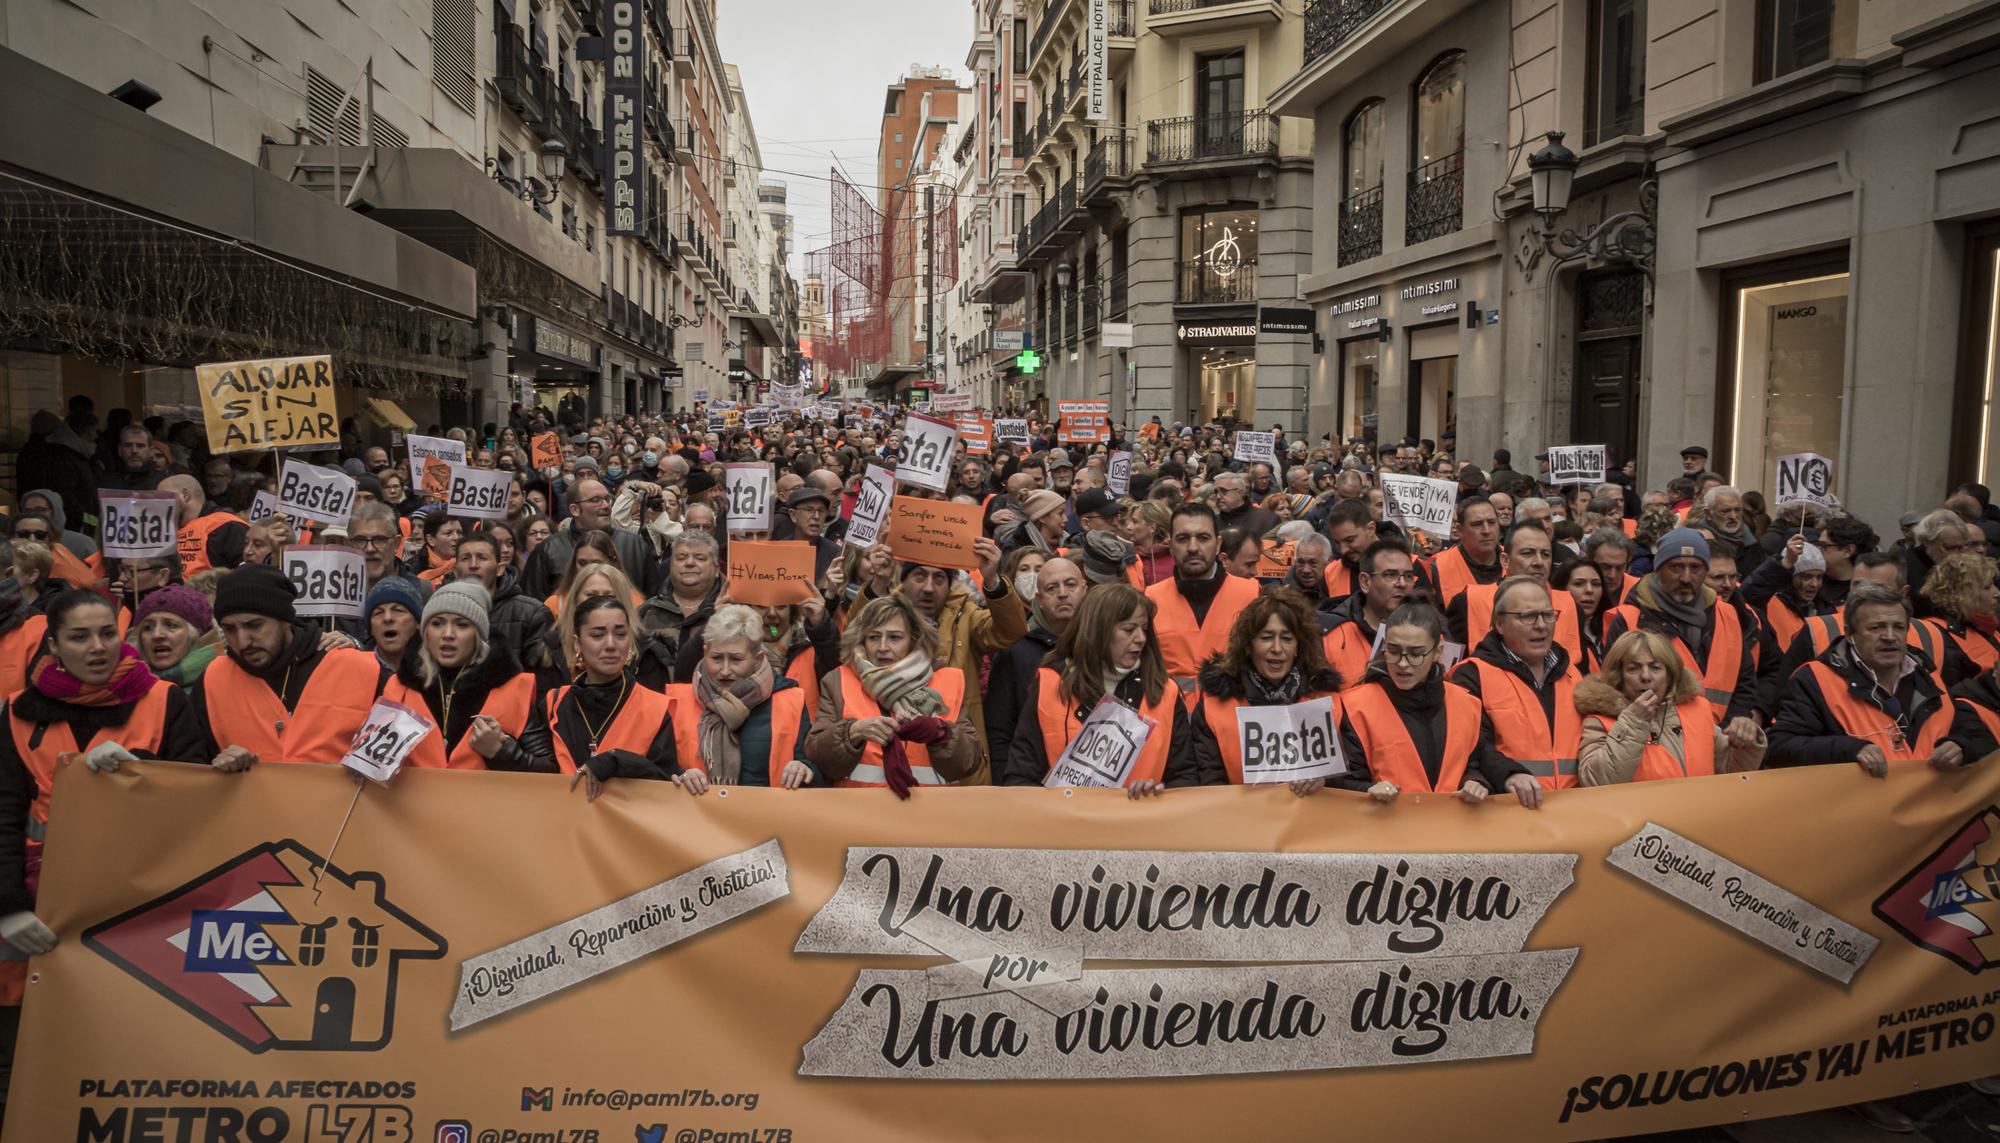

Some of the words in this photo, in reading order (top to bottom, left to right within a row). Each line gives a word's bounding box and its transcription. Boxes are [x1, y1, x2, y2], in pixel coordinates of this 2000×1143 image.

[1092, 34, 1103, 115] PETITPALACE
[614, 94, 634, 231] SPORT
[1330, 294, 1379, 316] intimissimi
[1400, 278, 1457, 301] intimissimi
[1187, 325, 1257, 337] STRADIVARIUS
[1777, 306, 1817, 321] MANGO
[1550, 450, 1604, 474] ¡Justicia!
[281, 471, 355, 515] Basta!
[449, 477, 511, 509] Basta!
[1388, 502, 1423, 516] PISO
[105, 505, 173, 544] Basta!
[288, 559, 365, 603] Basta!
[1077, 727, 1125, 772] DIGNA
[1244, 711, 1336, 766] Basta!
[860, 853, 1026, 938] Una
[1048, 862, 1323, 934] vivienda
[1345, 858, 1521, 954] digna
[465, 945, 565, 1005] ¡Dignidad,
[680, 894, 698, 923] y
[699, 858, 777, 907] Justicia!
[982, 949, 1049, 991] por
[859, 982, 1029, 1069] Una
[1053, 979, 1326, 1057] vivienda
[1350, 964, 1530, 1056] digna.
[1877, 995, 1978, 1028] PLATAFORMA
[1874, 1012, 1996, 1064] METRO
[79, 1079, 260, 1098] PLATAFORMA
[264, 1079, 416, 1099] AFECTADOS
[1558, 1049, 1811, 1123] ¡SOLUCIONES
[1815, 1039, 1870, 1082] YA!
[76, 1105, 291, 1143] METRO
[303, 1103, 413, 1143] L7B
